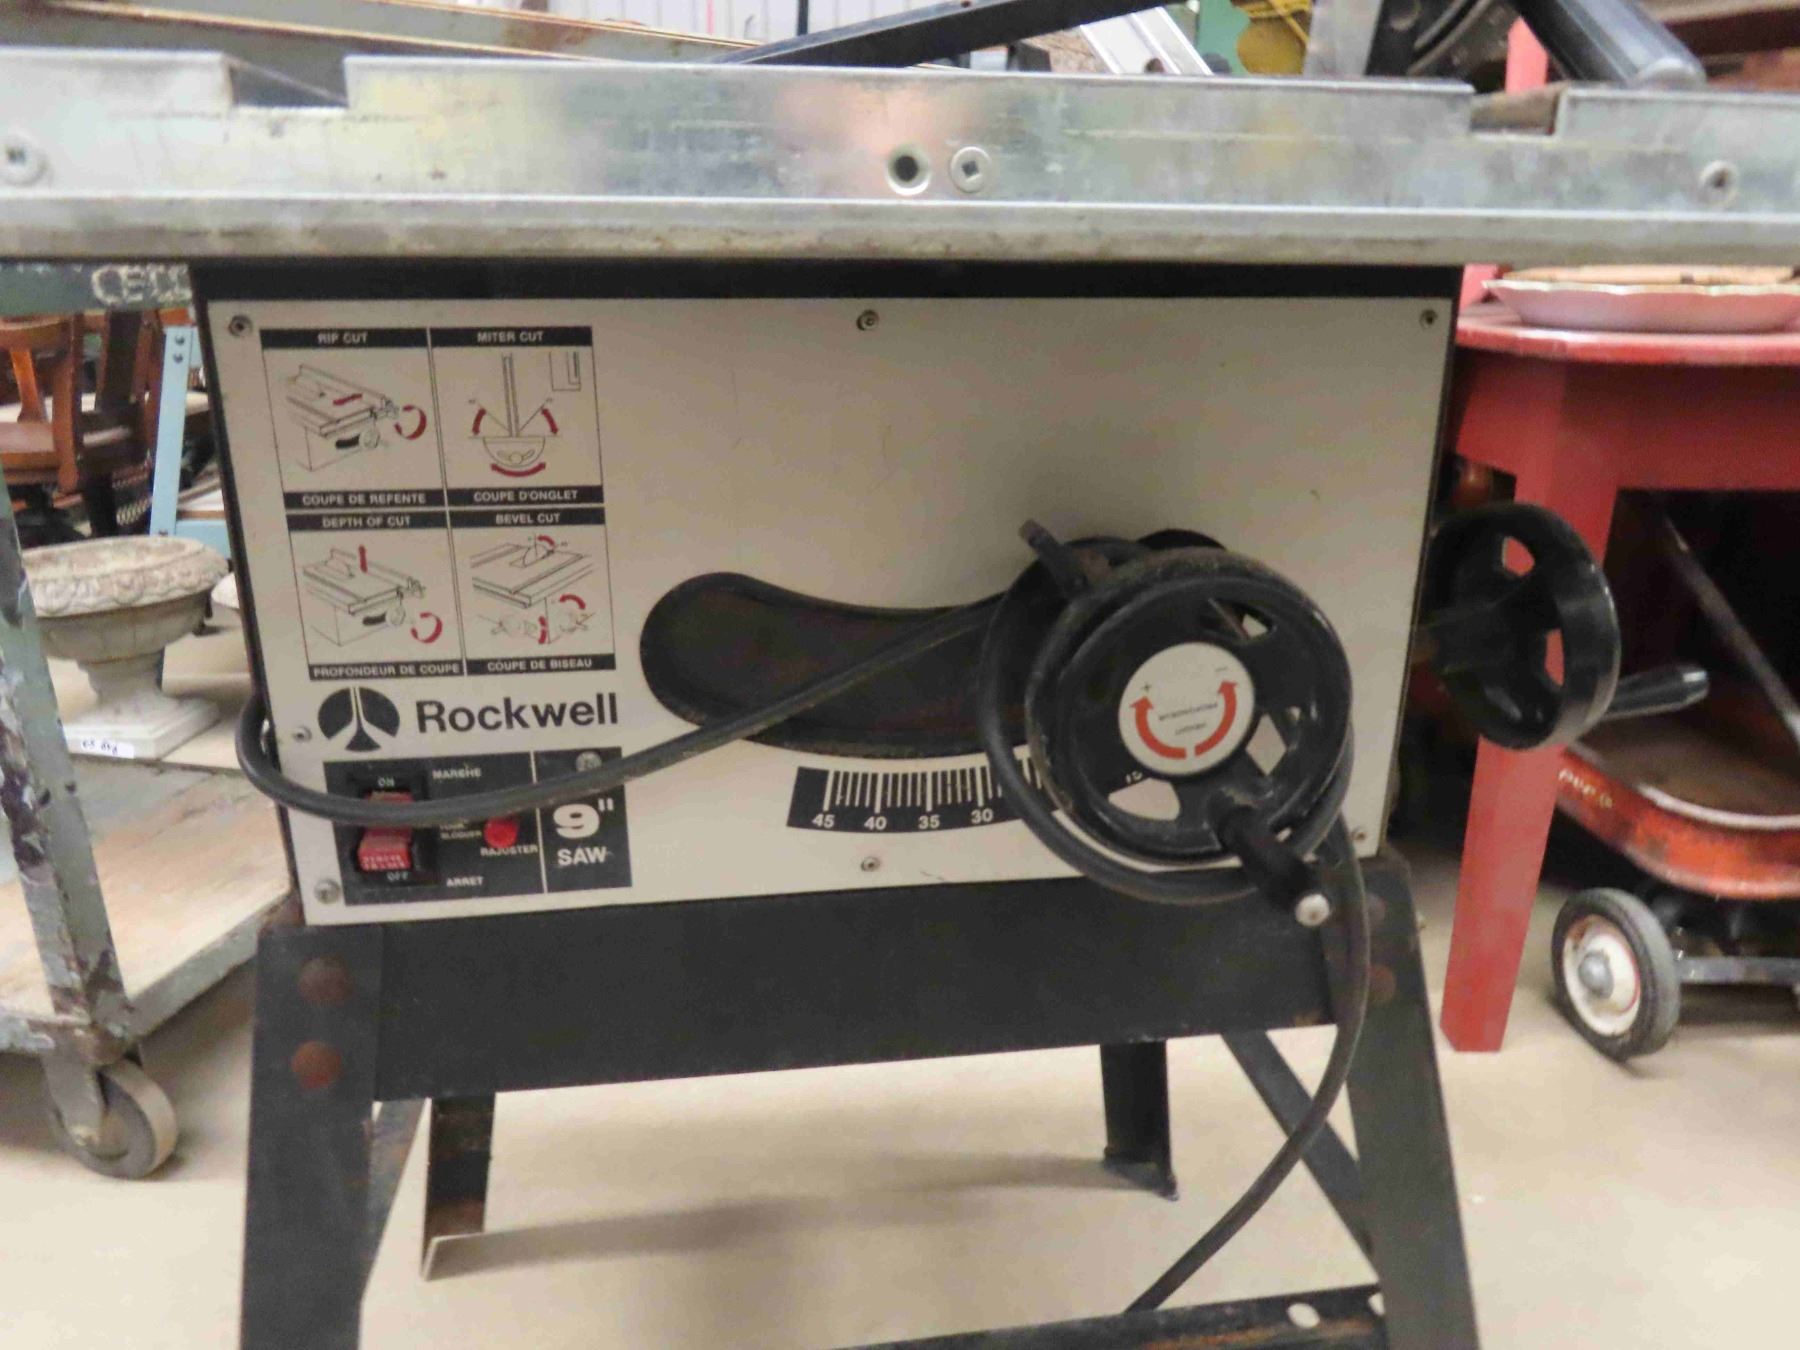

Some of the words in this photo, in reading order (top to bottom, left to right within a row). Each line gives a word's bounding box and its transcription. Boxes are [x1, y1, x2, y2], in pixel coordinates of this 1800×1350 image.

[317, 333, 338, 344] RIP
[342, 333, 367, 344] CUT
[477, 332, 515, 343] MITER
[519, 331, 544, 342] CUT
[303, 494, 345, 506] COUPE
[349, 494, 365, 505] DE
[369, 493, 426, 504] REFENTE
[473, 491, 514, 502] COUPE
[518, 489, 578, 501] D'ONGLET
[322, 516, 363, 528] DEPTH
[367, 516, 384, 527] OF
[387, 515, 411, 527] CUT
[495, 513, 533, 525] BEVEL
[537, 512, 560, 524] CUT
[313, 664, 396, 678] PROFONDEUR
[400, 664, 416, 676] DE
[420, 662, 460, 676] COUPE
[487, 660, 526, 673] COUPE
[530, 659, 546, 671] DE
[550, 658, 593, 670] BISEAU
[415, 692, 618, 733] Rockwell
[377, 777, 395, 788] ON
[812, 813, 835, 829] 45
[864, 815, 887, 831] 40
[918, 814, 940, 829] 35
[971, 808, 993, 824] 30
[556, 846, 607, 867] SAW
[446, 875, 483, 888] ARRET
